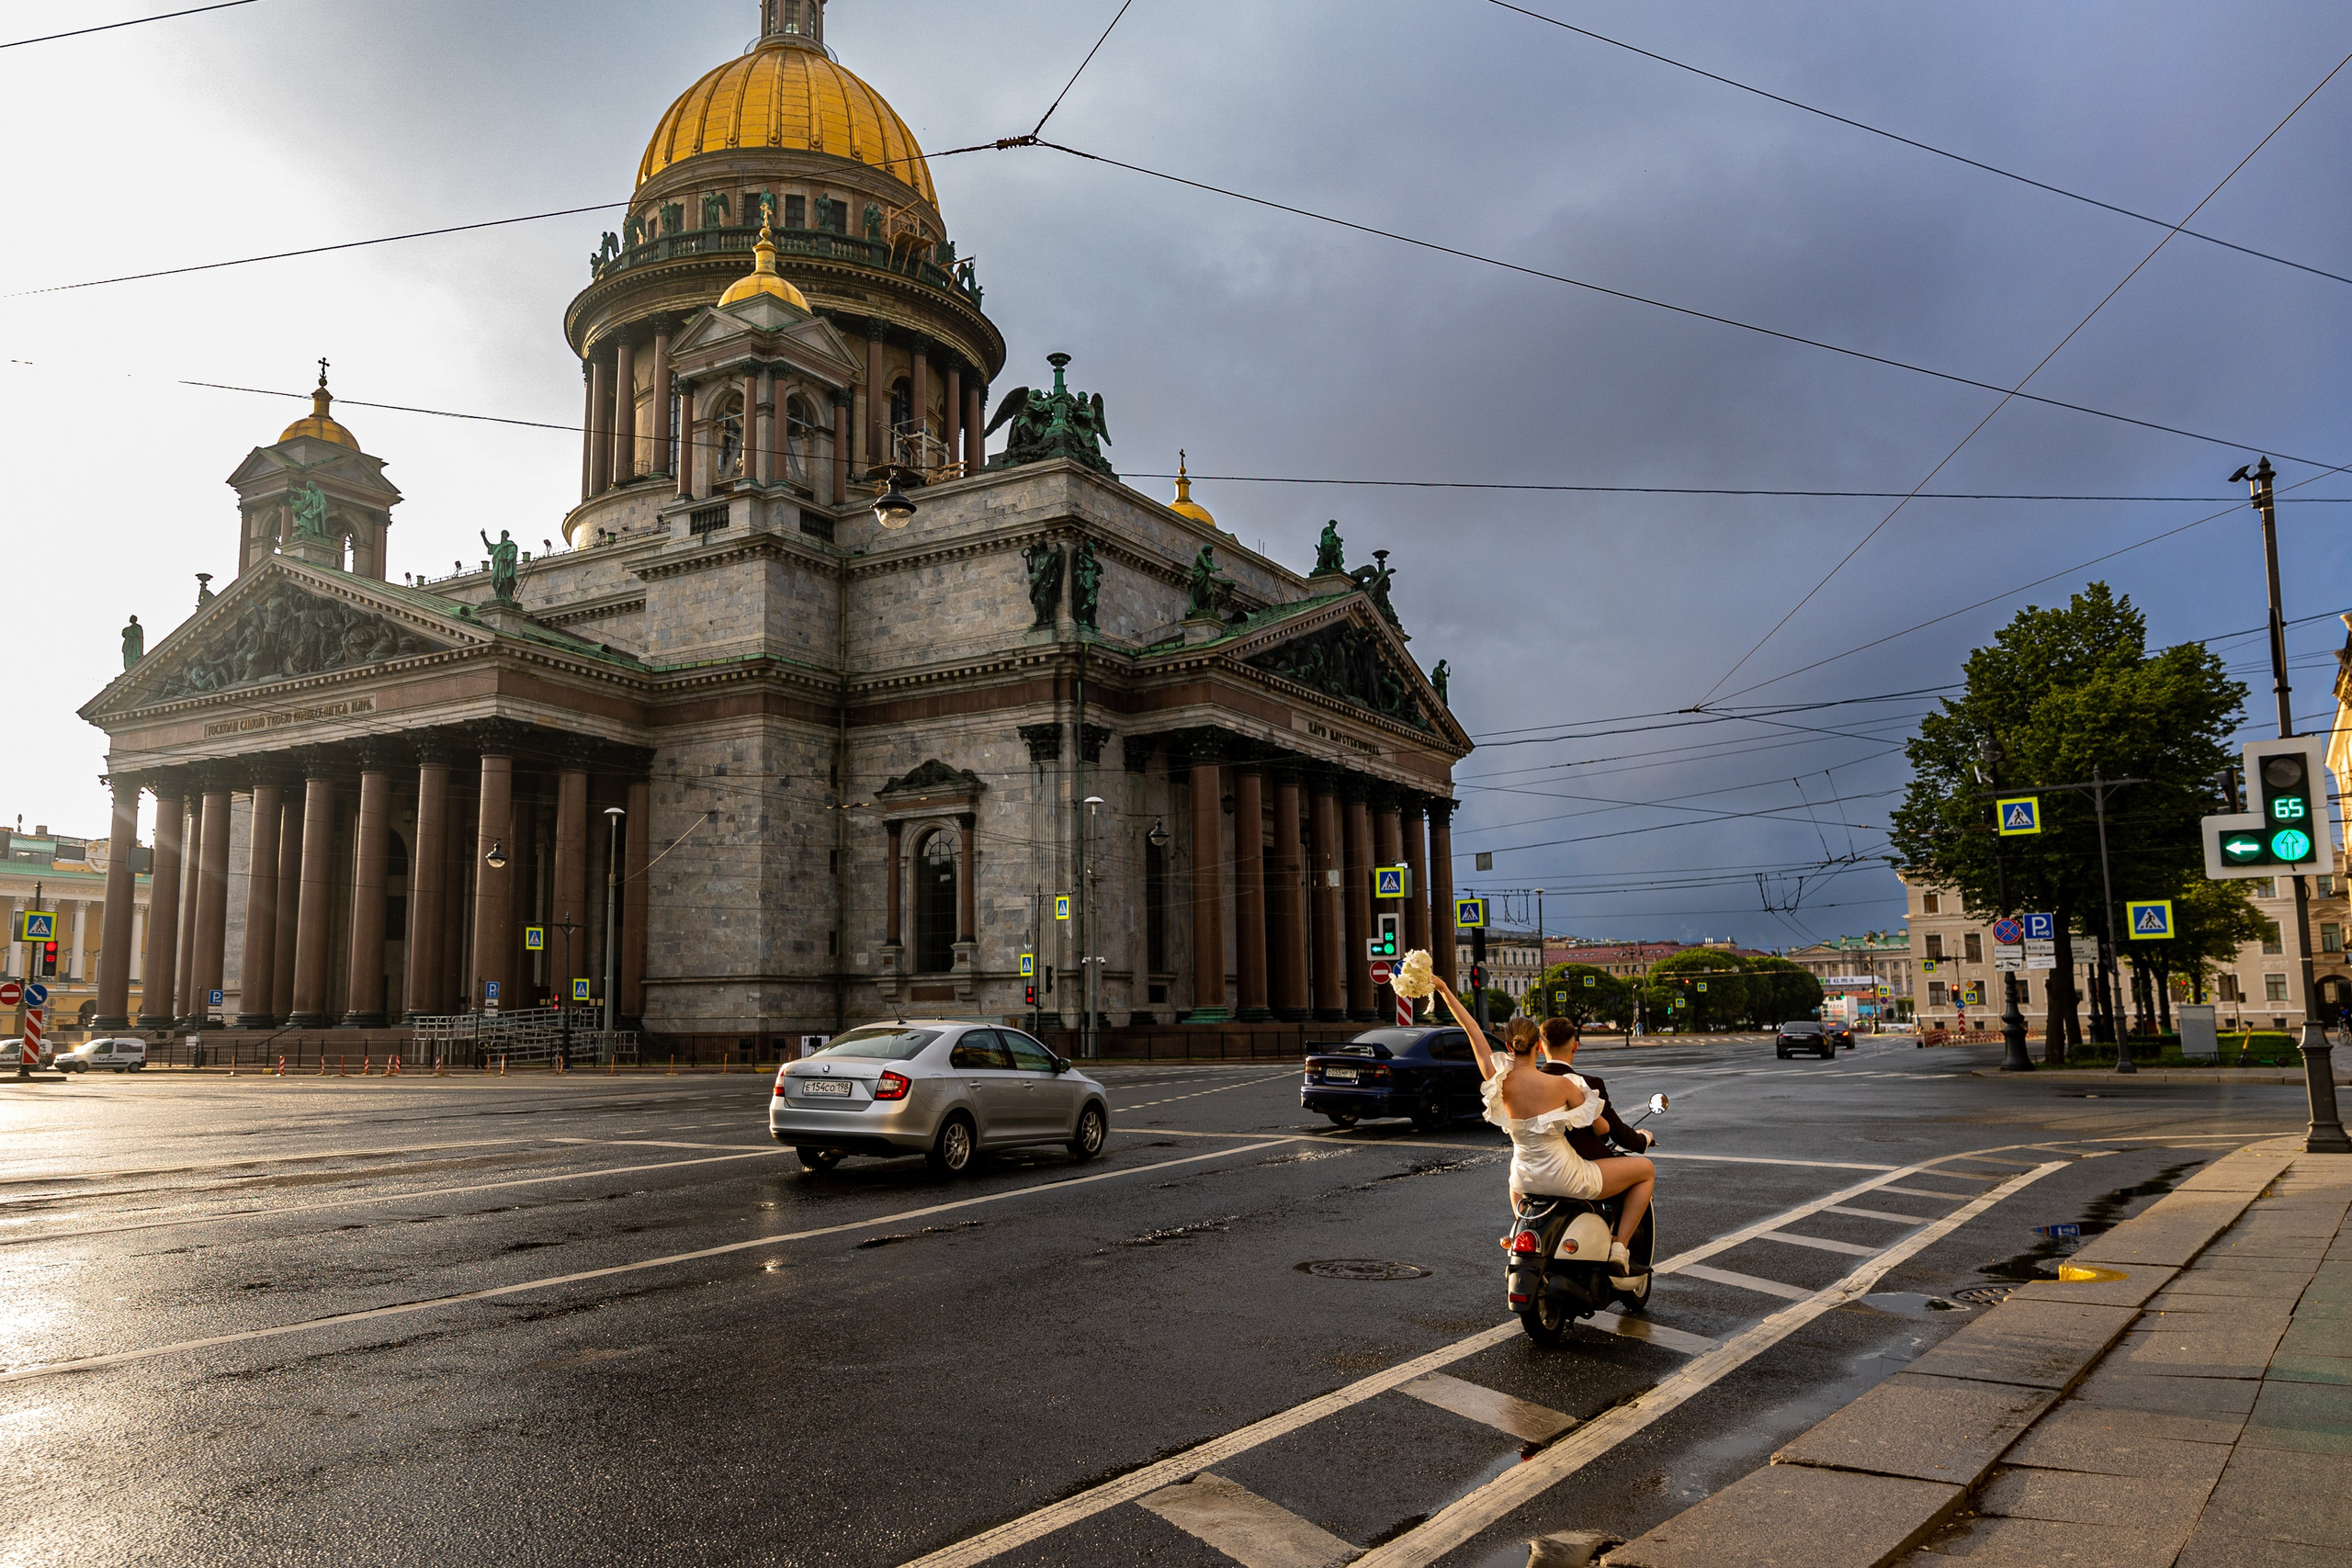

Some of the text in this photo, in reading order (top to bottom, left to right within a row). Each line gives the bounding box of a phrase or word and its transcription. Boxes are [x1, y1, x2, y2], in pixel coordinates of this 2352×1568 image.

[2274, 797, 2304, 818] 65
[2031, 917, 2048, 936] P
[1385, 931, 1395, 941] 65
[837, 1083, 849, 1091] 198
